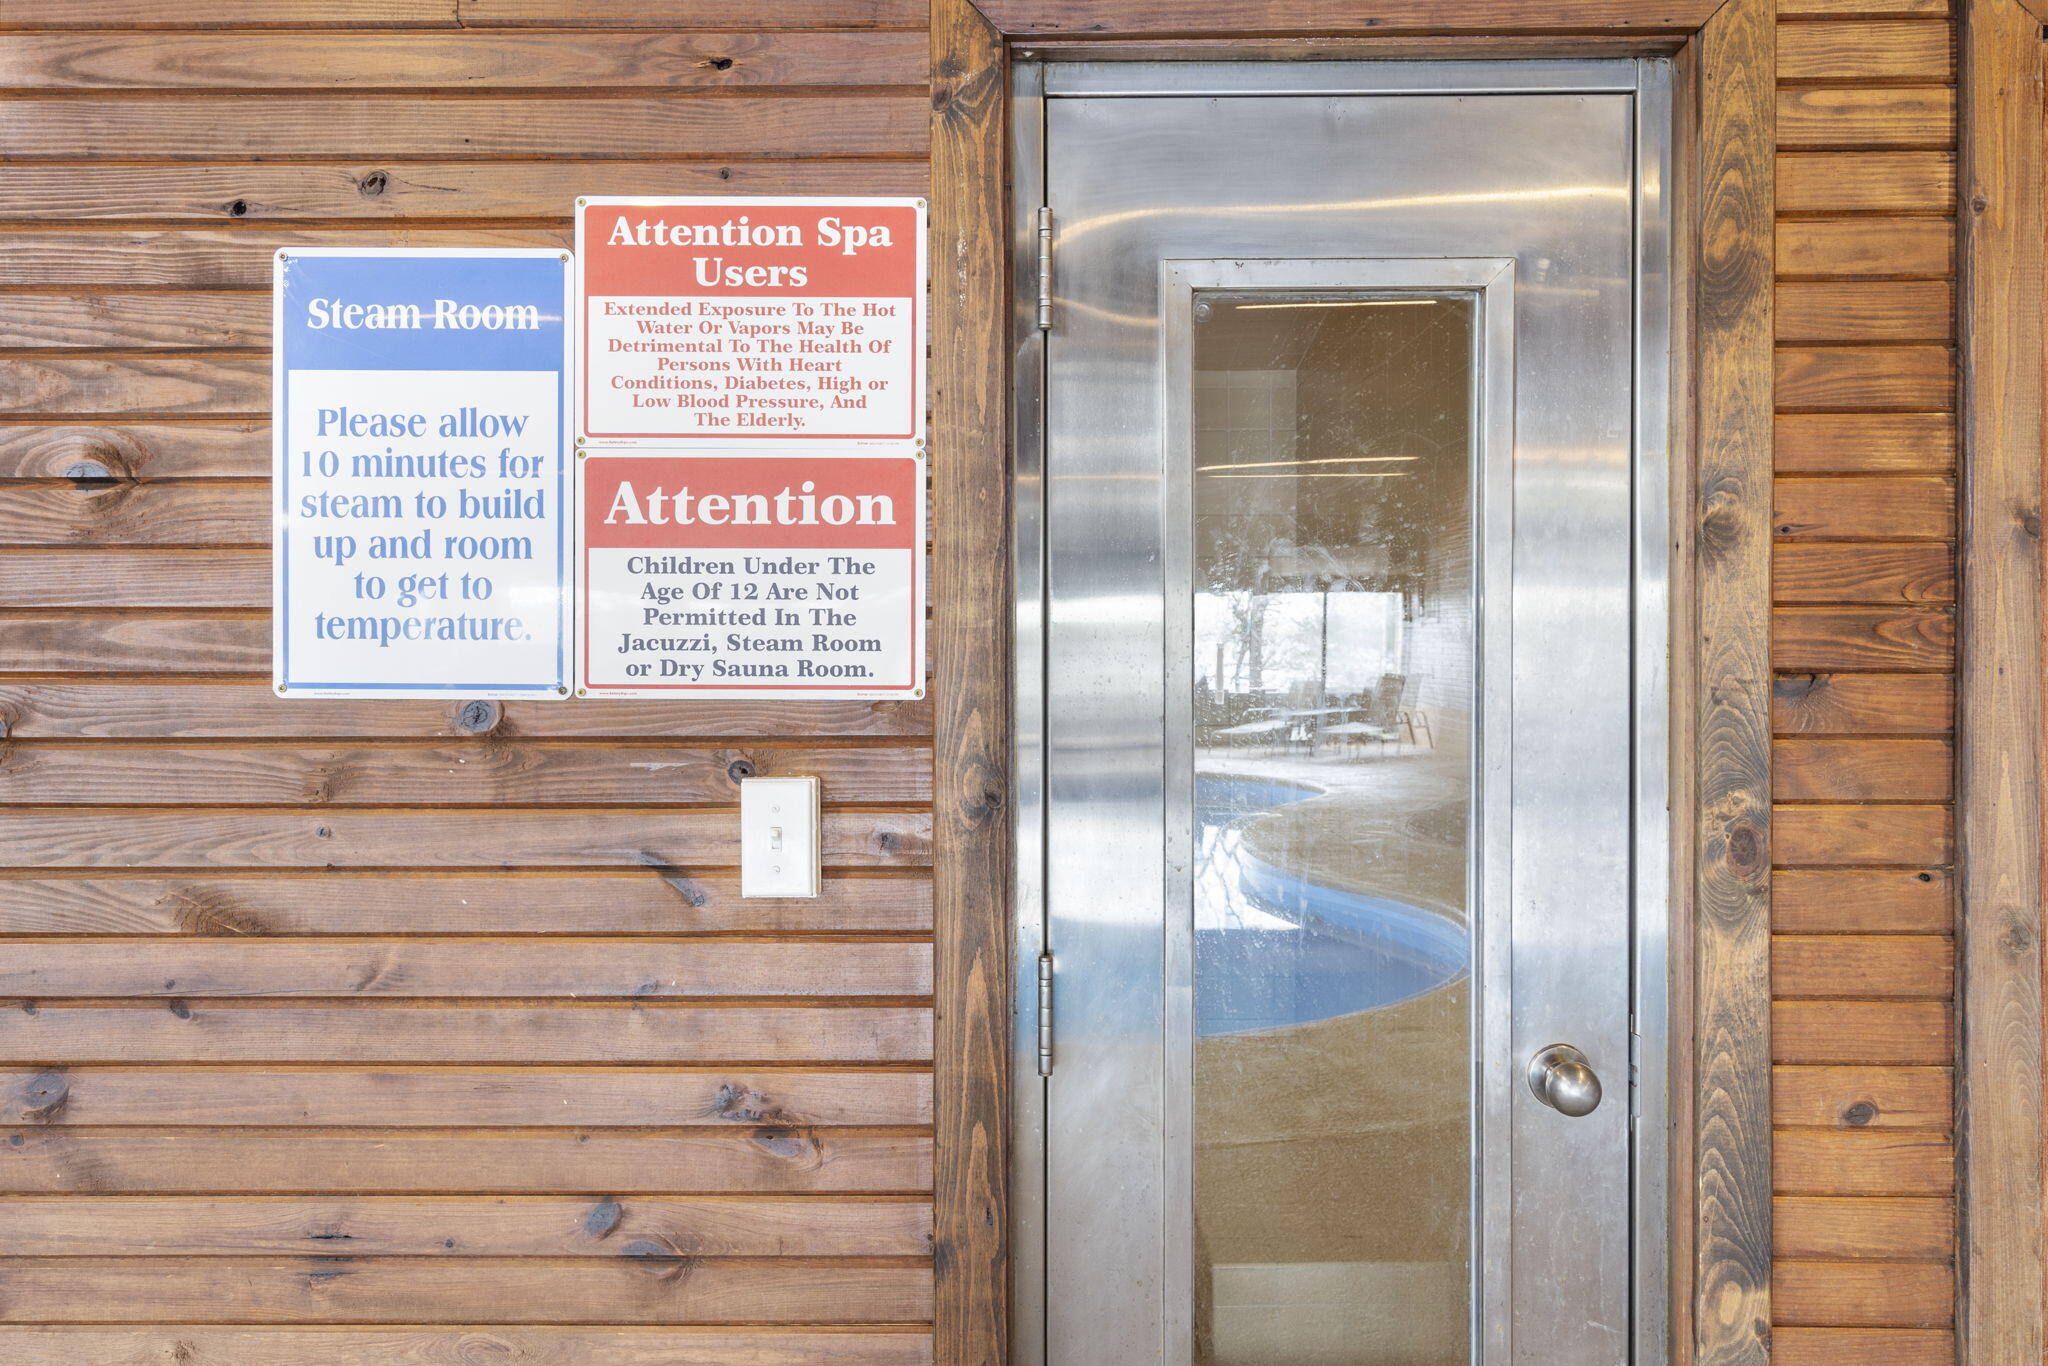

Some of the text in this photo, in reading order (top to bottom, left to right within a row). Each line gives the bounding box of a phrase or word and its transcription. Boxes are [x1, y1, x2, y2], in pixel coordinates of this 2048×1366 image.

[607, 216, 893, 255] Attention Spa
[692, 257, 808, 287] Users
[307, 298, 540, 330] Steam Room
[604, 302, 896, 320] Extended Exposure To The Hot
[636, 320, 865, 339] Water Or Vapors May Be
[608, 339, 892, 353] Detrimental To The Health Of
[657, 357, 842, 372] Persons With Heart
[611, 375, 888, 394] Conditions, Diabetes, High or
[632, 393, 867, 411] Low Blood Pressure, And
[317, 406, 530, 438] Please allow
[694, 412, 805, 430] The Elderly.
[303, 447, 544, 479] 10 minutes for
[301, 488, 546, 520] steam to build
[604, 481, 896, 525] Attention
[313, 529, 533, 566] up and room
[627, 556, 875, 576] Children Under The
[354, 571, 493, 608] to get to
[640, 582, 859, 605] Age Of 12 Are Not
[643, 608, 856, 626] Permitted In The
[315, 611, 531, 648] temperature.
[618, 633, 882, 655] Jacuzzi, Steam Room
[626, 659, 874, 682] or Dry Sauna Room.
